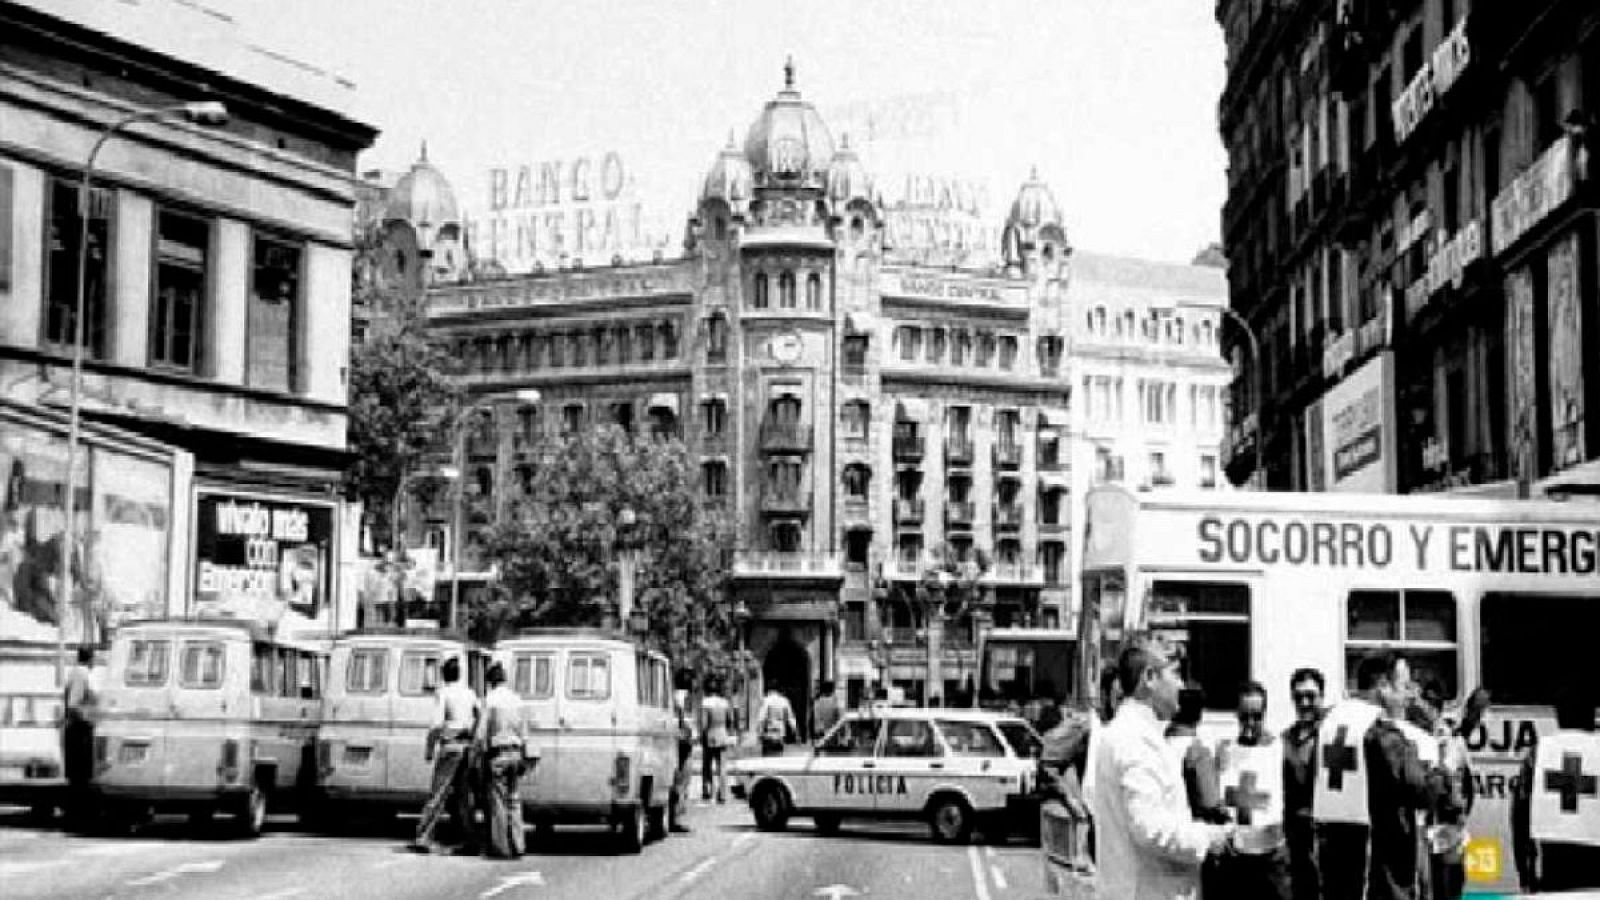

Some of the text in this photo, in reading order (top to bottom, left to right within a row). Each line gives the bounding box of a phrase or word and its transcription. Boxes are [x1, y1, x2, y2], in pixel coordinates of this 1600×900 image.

[489, 151, 624, 211] BANCO
[245, 538, 279, 566] con
[1199, 516, 1600, 574] SOCORRO Y EMERG
[1465, 719, 1538, 750] OJA
[834, 774, 908, 795] POLICIA
